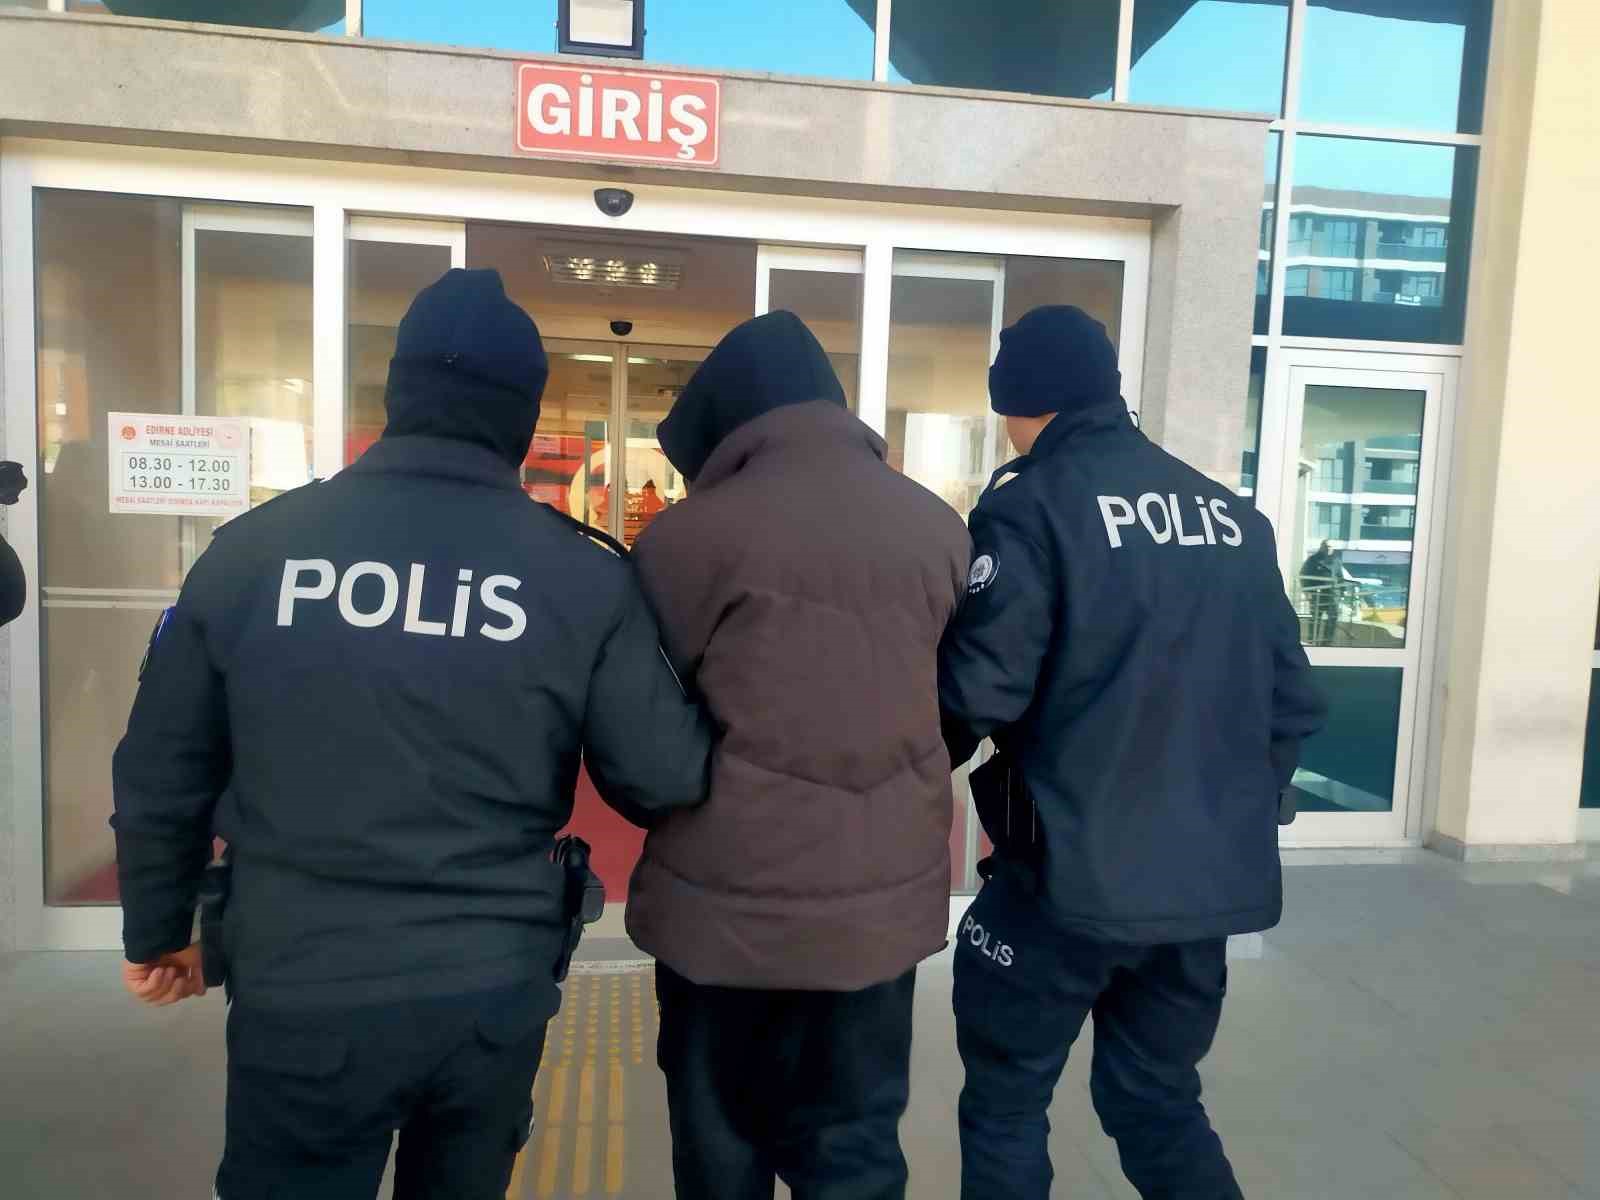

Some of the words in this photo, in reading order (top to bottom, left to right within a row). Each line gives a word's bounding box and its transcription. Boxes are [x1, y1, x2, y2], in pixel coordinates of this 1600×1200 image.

[527, 74, 709, 160] GİRİŞ
[129, 457, 172, 470] 08.30
[189, 459, 231, 472] 12.00
[129, 476, 172, 489] 13.00
[189, 478, 231, 491] 17.30
